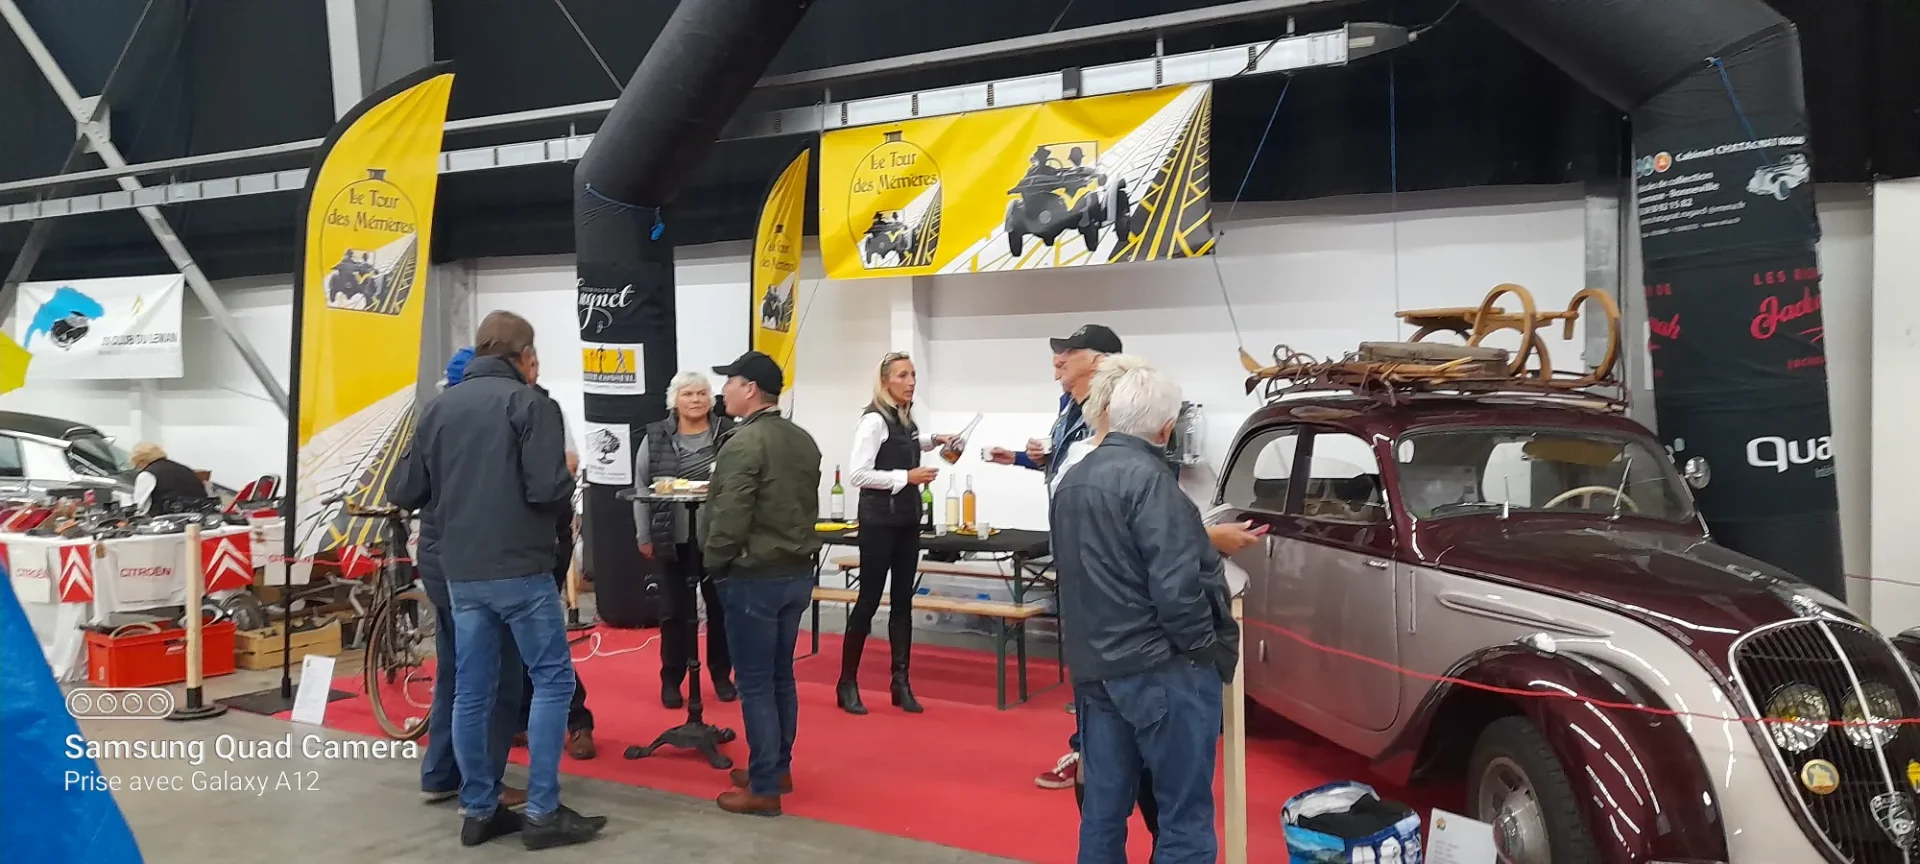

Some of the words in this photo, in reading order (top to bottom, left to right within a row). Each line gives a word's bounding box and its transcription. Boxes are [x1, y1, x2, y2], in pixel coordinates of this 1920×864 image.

[889, 151, 917, 168] Tour
[1674, 148, 1716, 162] Cabinet
[853, 177, 875, 194] des
[1667, 172, 1714, 187] collection
[1669, 182, 1721, 198] Bonneville
[369, 189, 400, 209] Tour
[328, 208, 350, 227] des
[1753, 270, 1788, 287] LES
[120, 566, 173, 578] CITROËN
